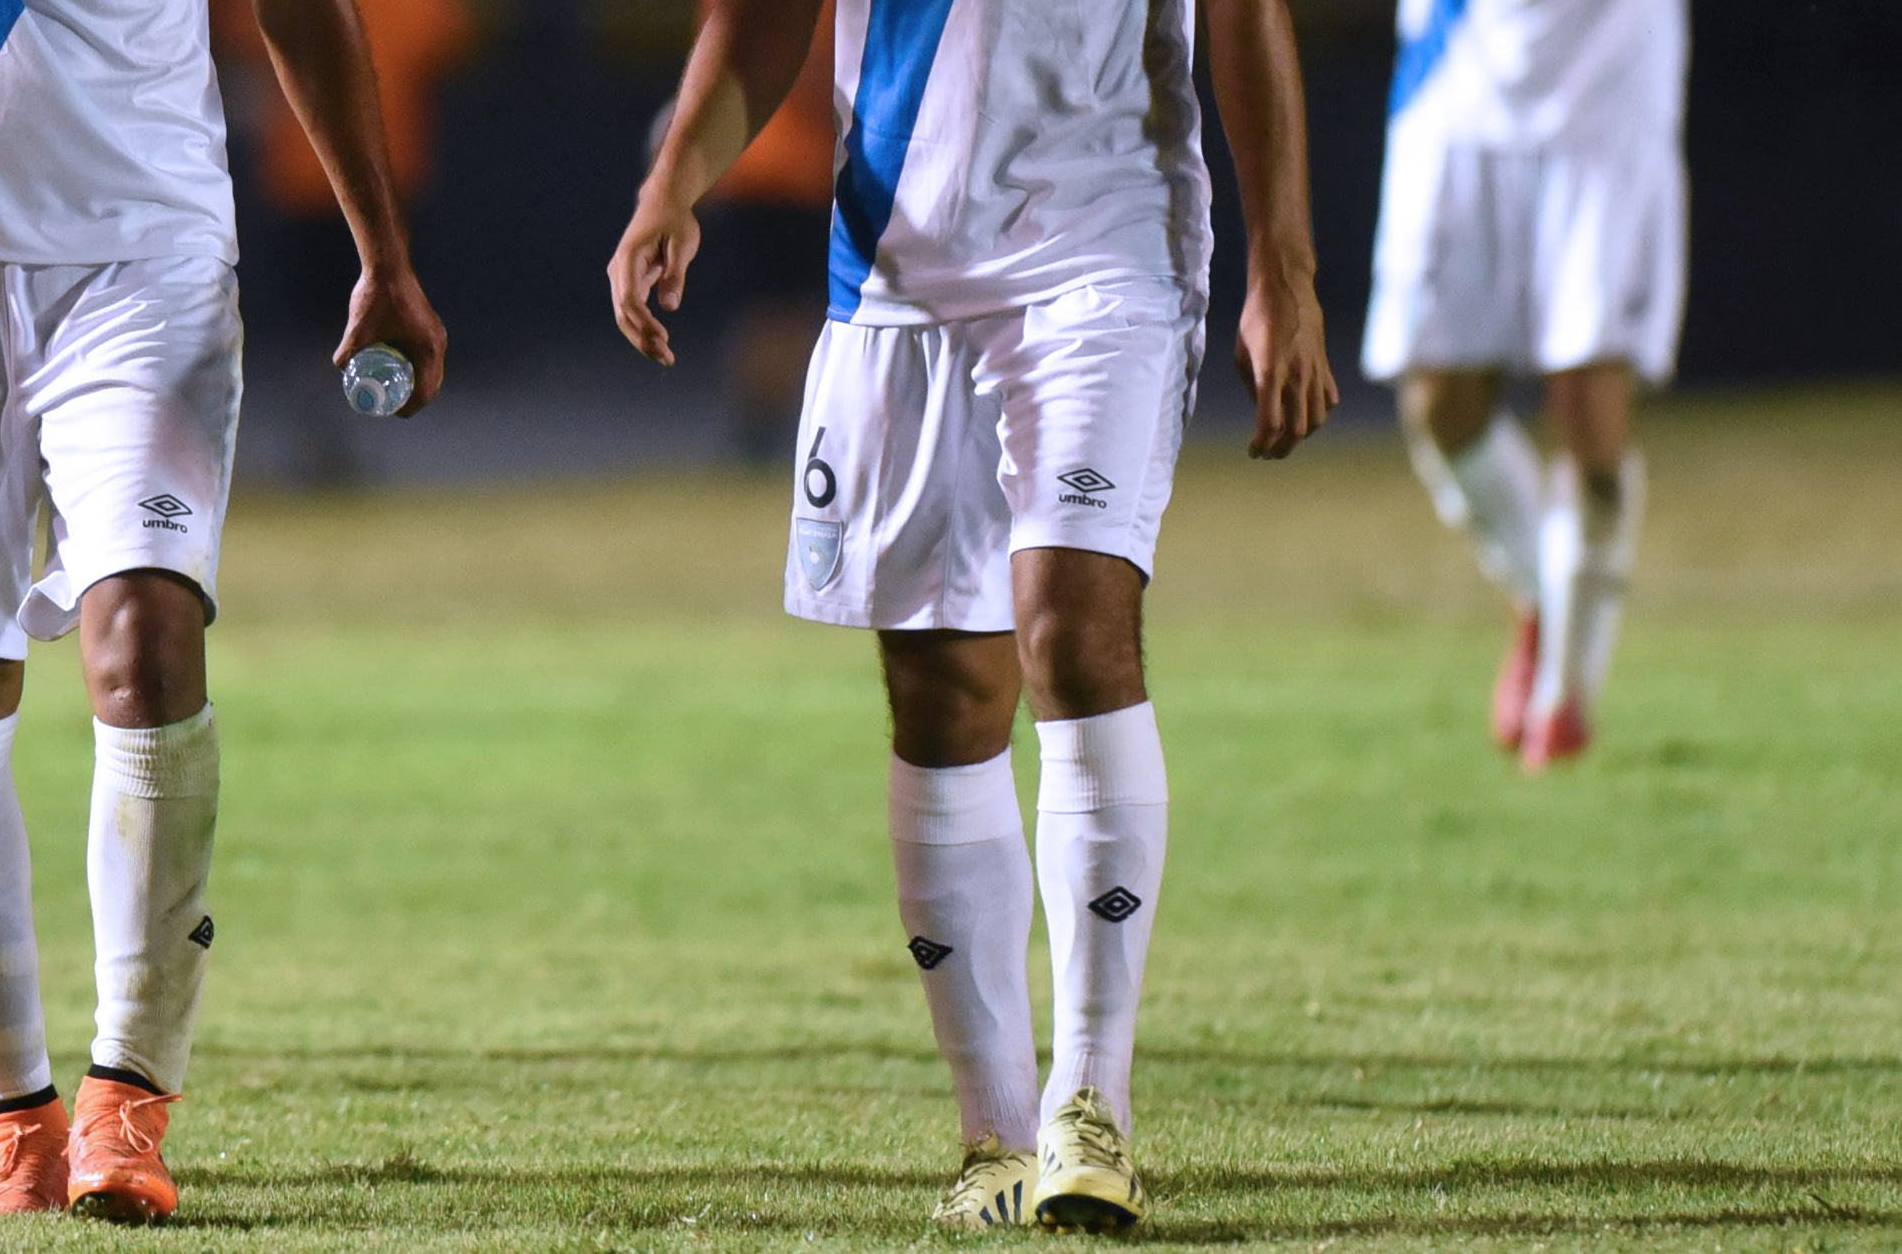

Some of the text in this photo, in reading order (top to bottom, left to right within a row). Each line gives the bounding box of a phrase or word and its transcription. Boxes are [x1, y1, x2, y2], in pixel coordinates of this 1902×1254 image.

[804, 426, 837, 509] 6
[1059, 493, 1107, 509] umbro
[142, 519, 188, 534] umbro
